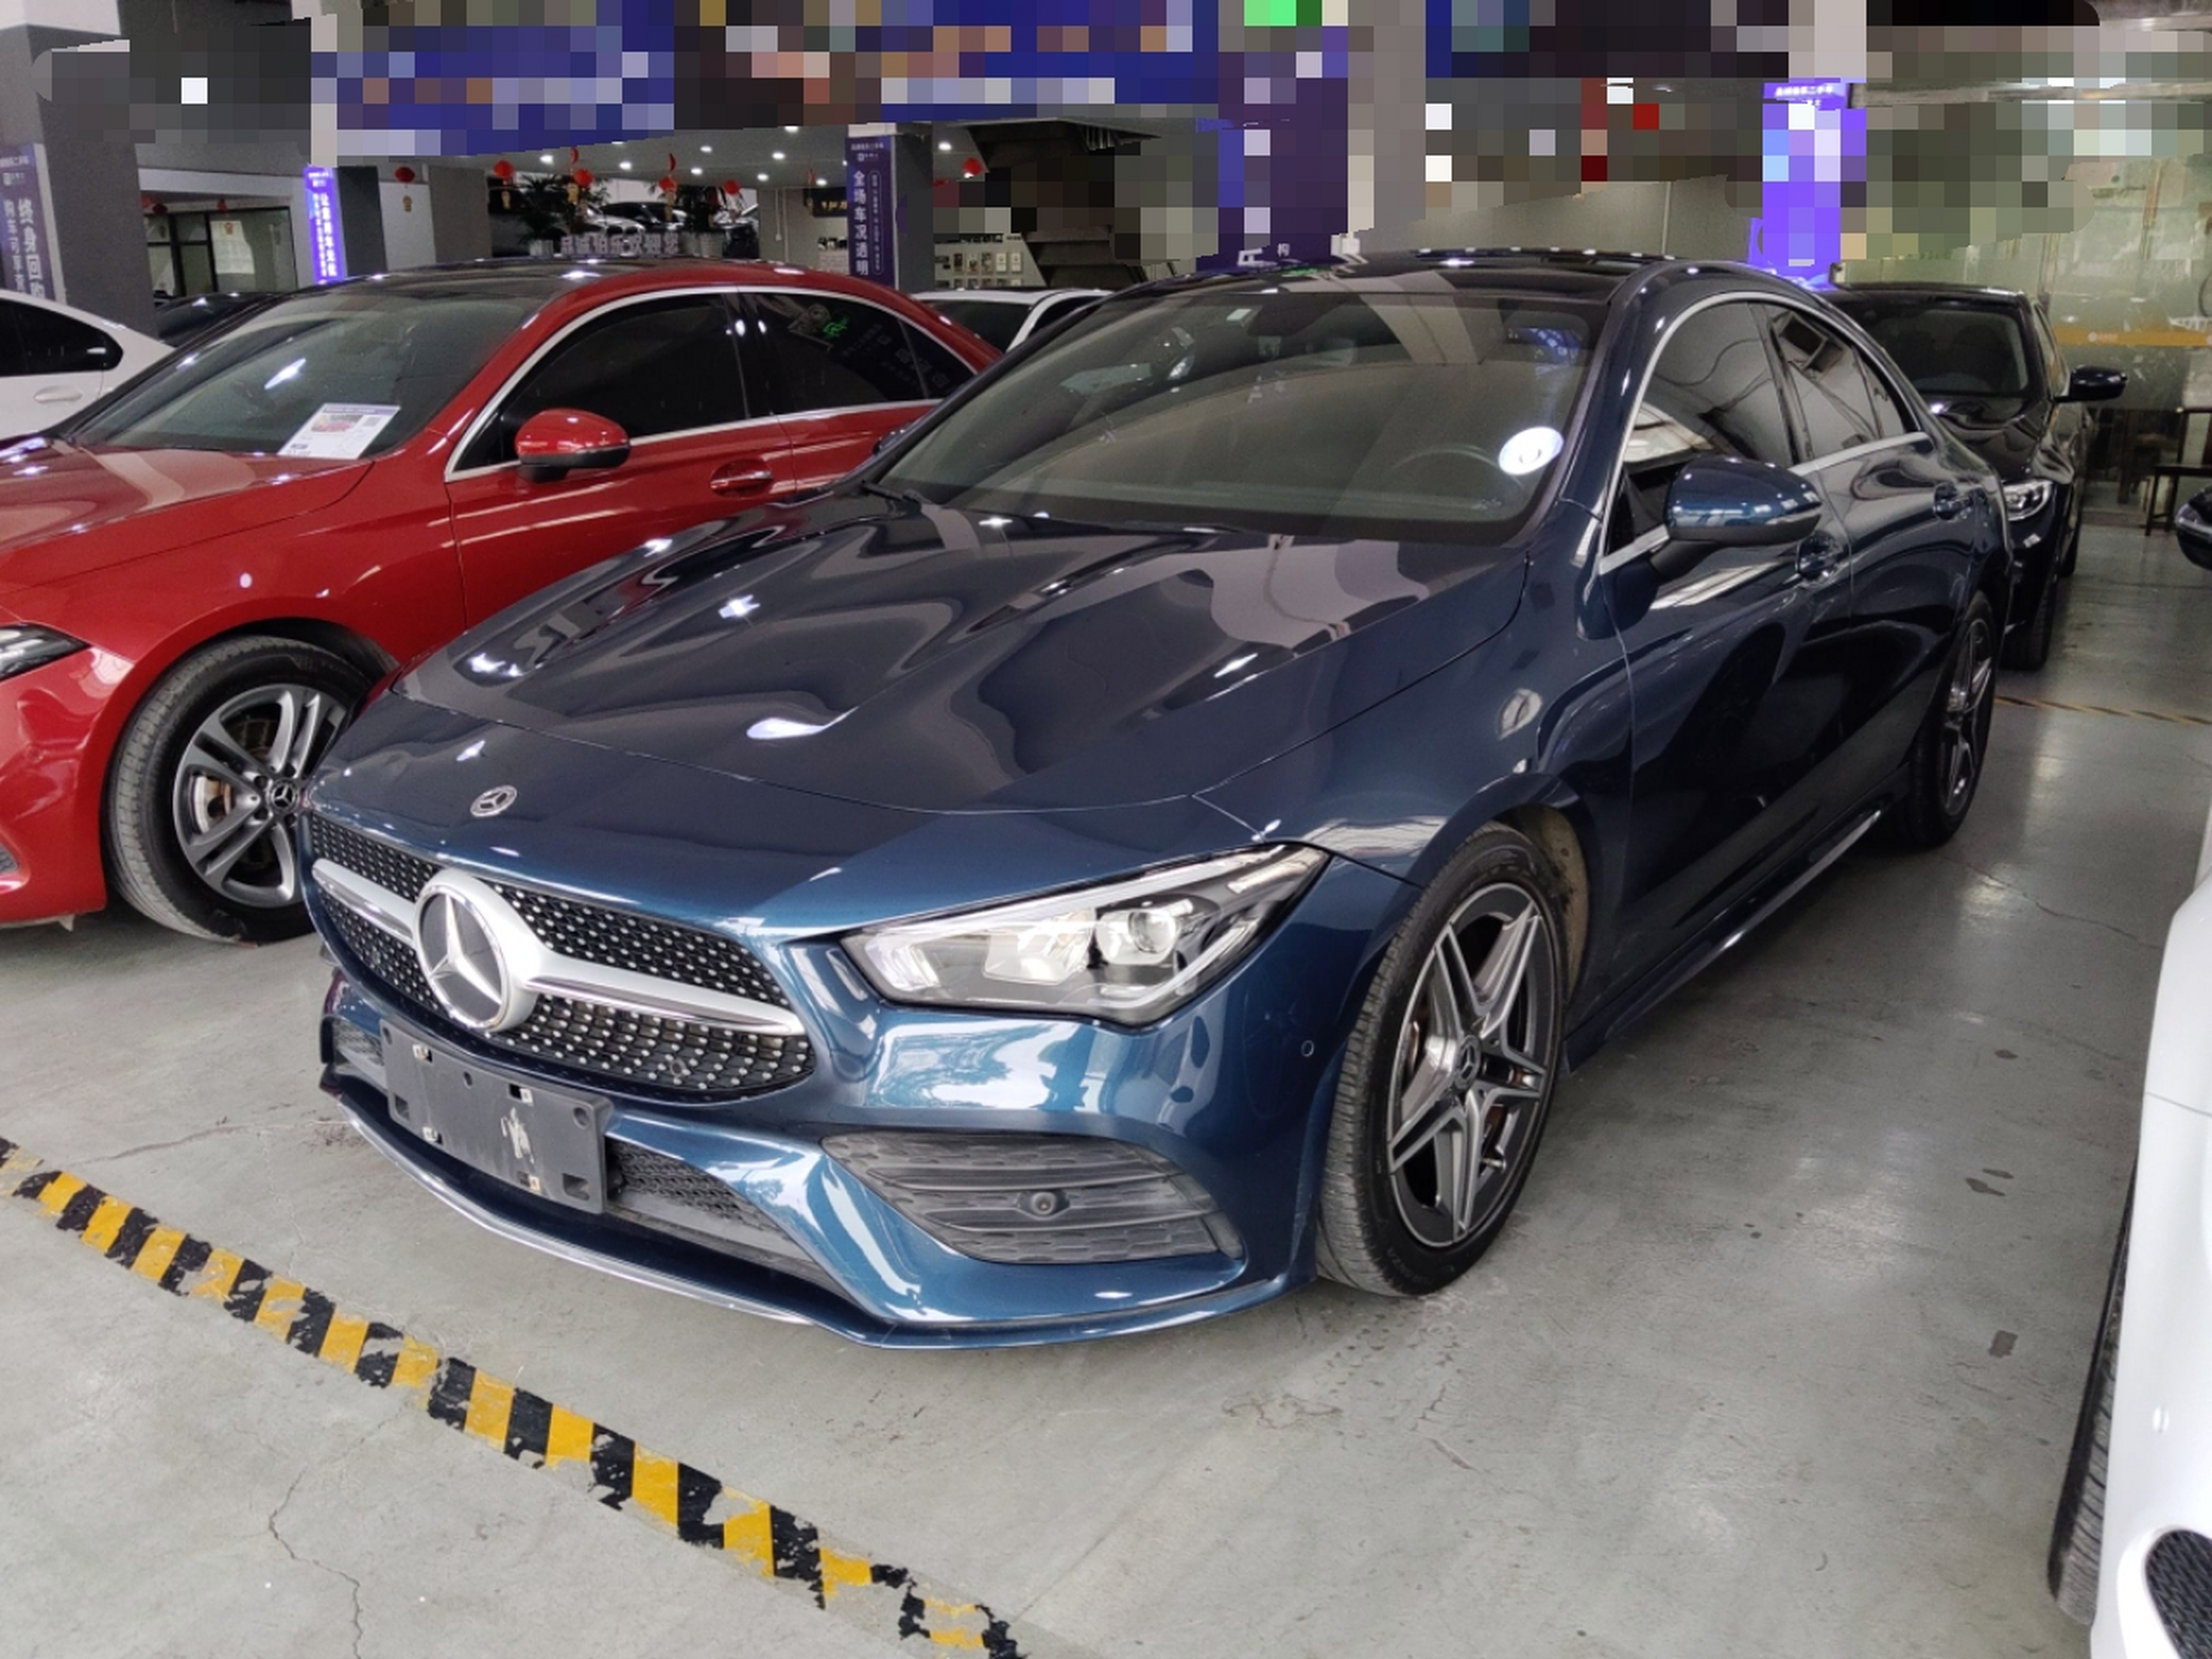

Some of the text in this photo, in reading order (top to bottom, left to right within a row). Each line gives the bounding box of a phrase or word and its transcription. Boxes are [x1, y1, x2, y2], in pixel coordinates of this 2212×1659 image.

[853, 170, 869, 276] 全场车况透明
